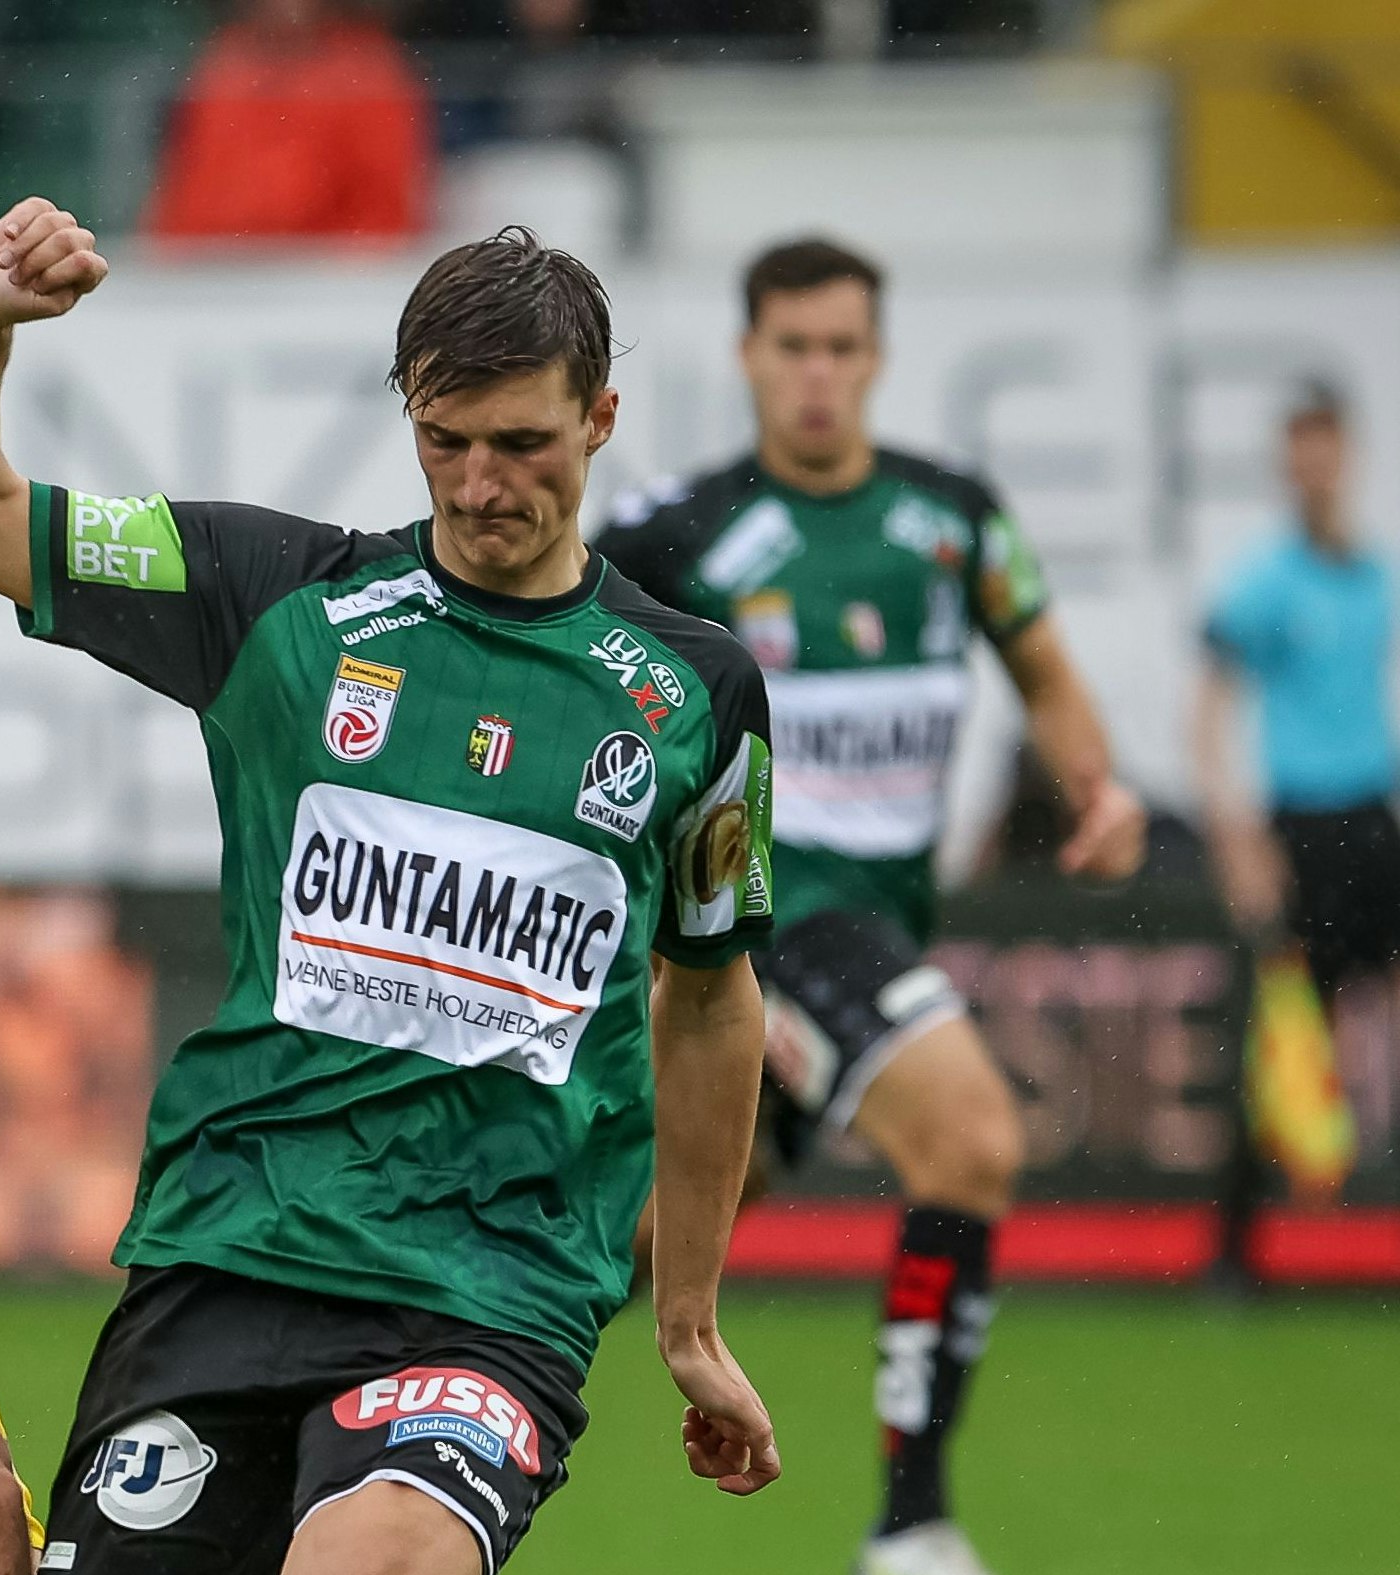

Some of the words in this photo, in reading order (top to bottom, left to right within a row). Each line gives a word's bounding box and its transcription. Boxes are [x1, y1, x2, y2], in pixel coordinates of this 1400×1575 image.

[74, 504, 130, 541] PY
[74, 541, 159, 582] BET
[341, 610, 429, 646] wallbox
[337, 680, 393, 702] BUNDES
[342, 663, 398, 685] ADMIRAL
[653, 666, 680, 702] KIA
[345, 692, 377, 709] LIGA
[293, 830, 616, 992] GUNTAMATIC
[353, 971, 420, 1007] BESTE
[357, 1375, 532, 1466] FUSSL
[402, 1418, 495, 1452] Modestraße
[455, 1455, 510, 1527] hummel
